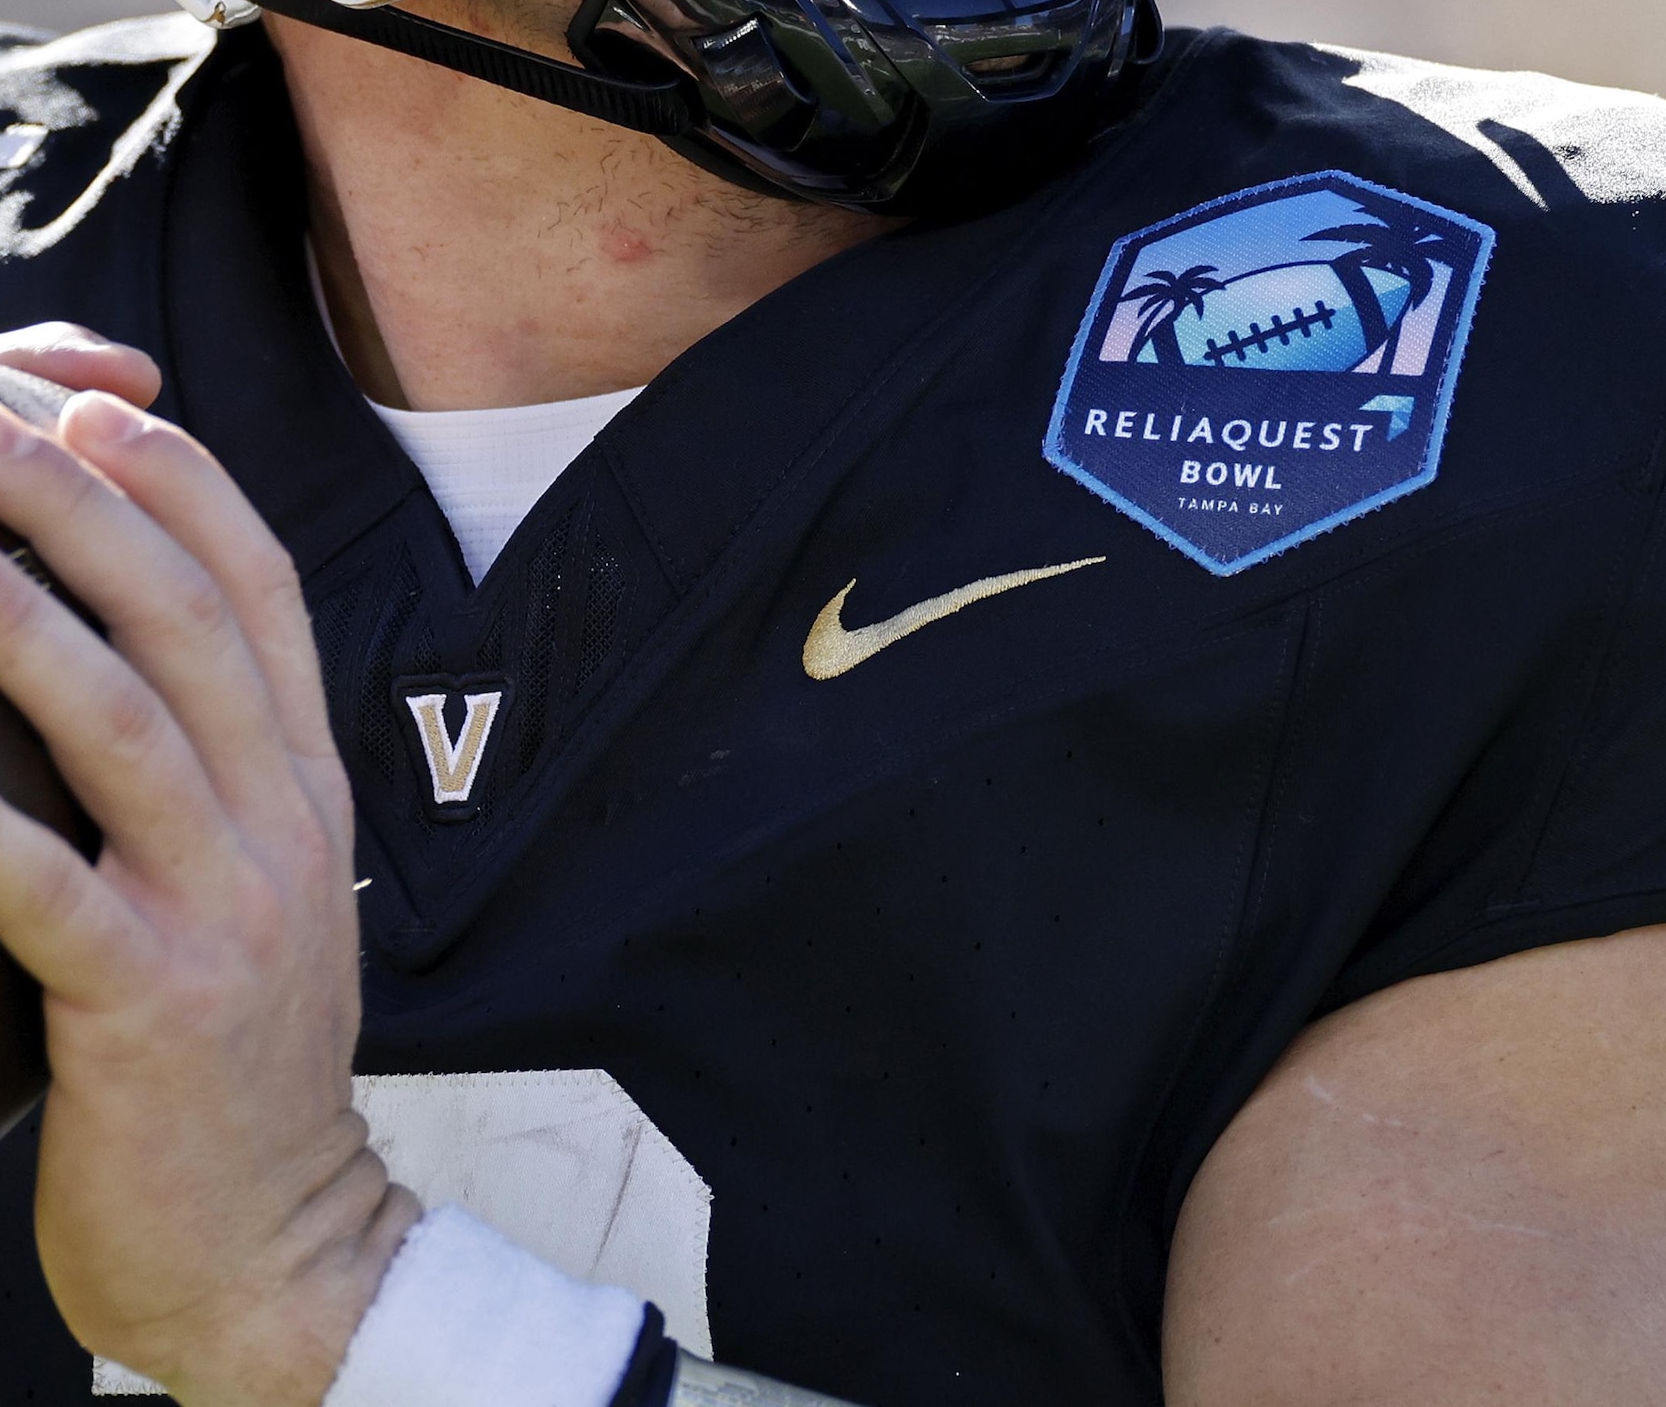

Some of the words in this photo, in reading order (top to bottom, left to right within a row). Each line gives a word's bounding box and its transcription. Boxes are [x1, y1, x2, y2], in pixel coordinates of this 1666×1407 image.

[1084, 408, 1374, 452] RELIAQUEST
[1180, 460, 1282, 490] BOWL
[1178, 497, 1239, 513] TAMPA
[1248, 502, 1283, 515] BAY
[406, 691, 504, 804] V
